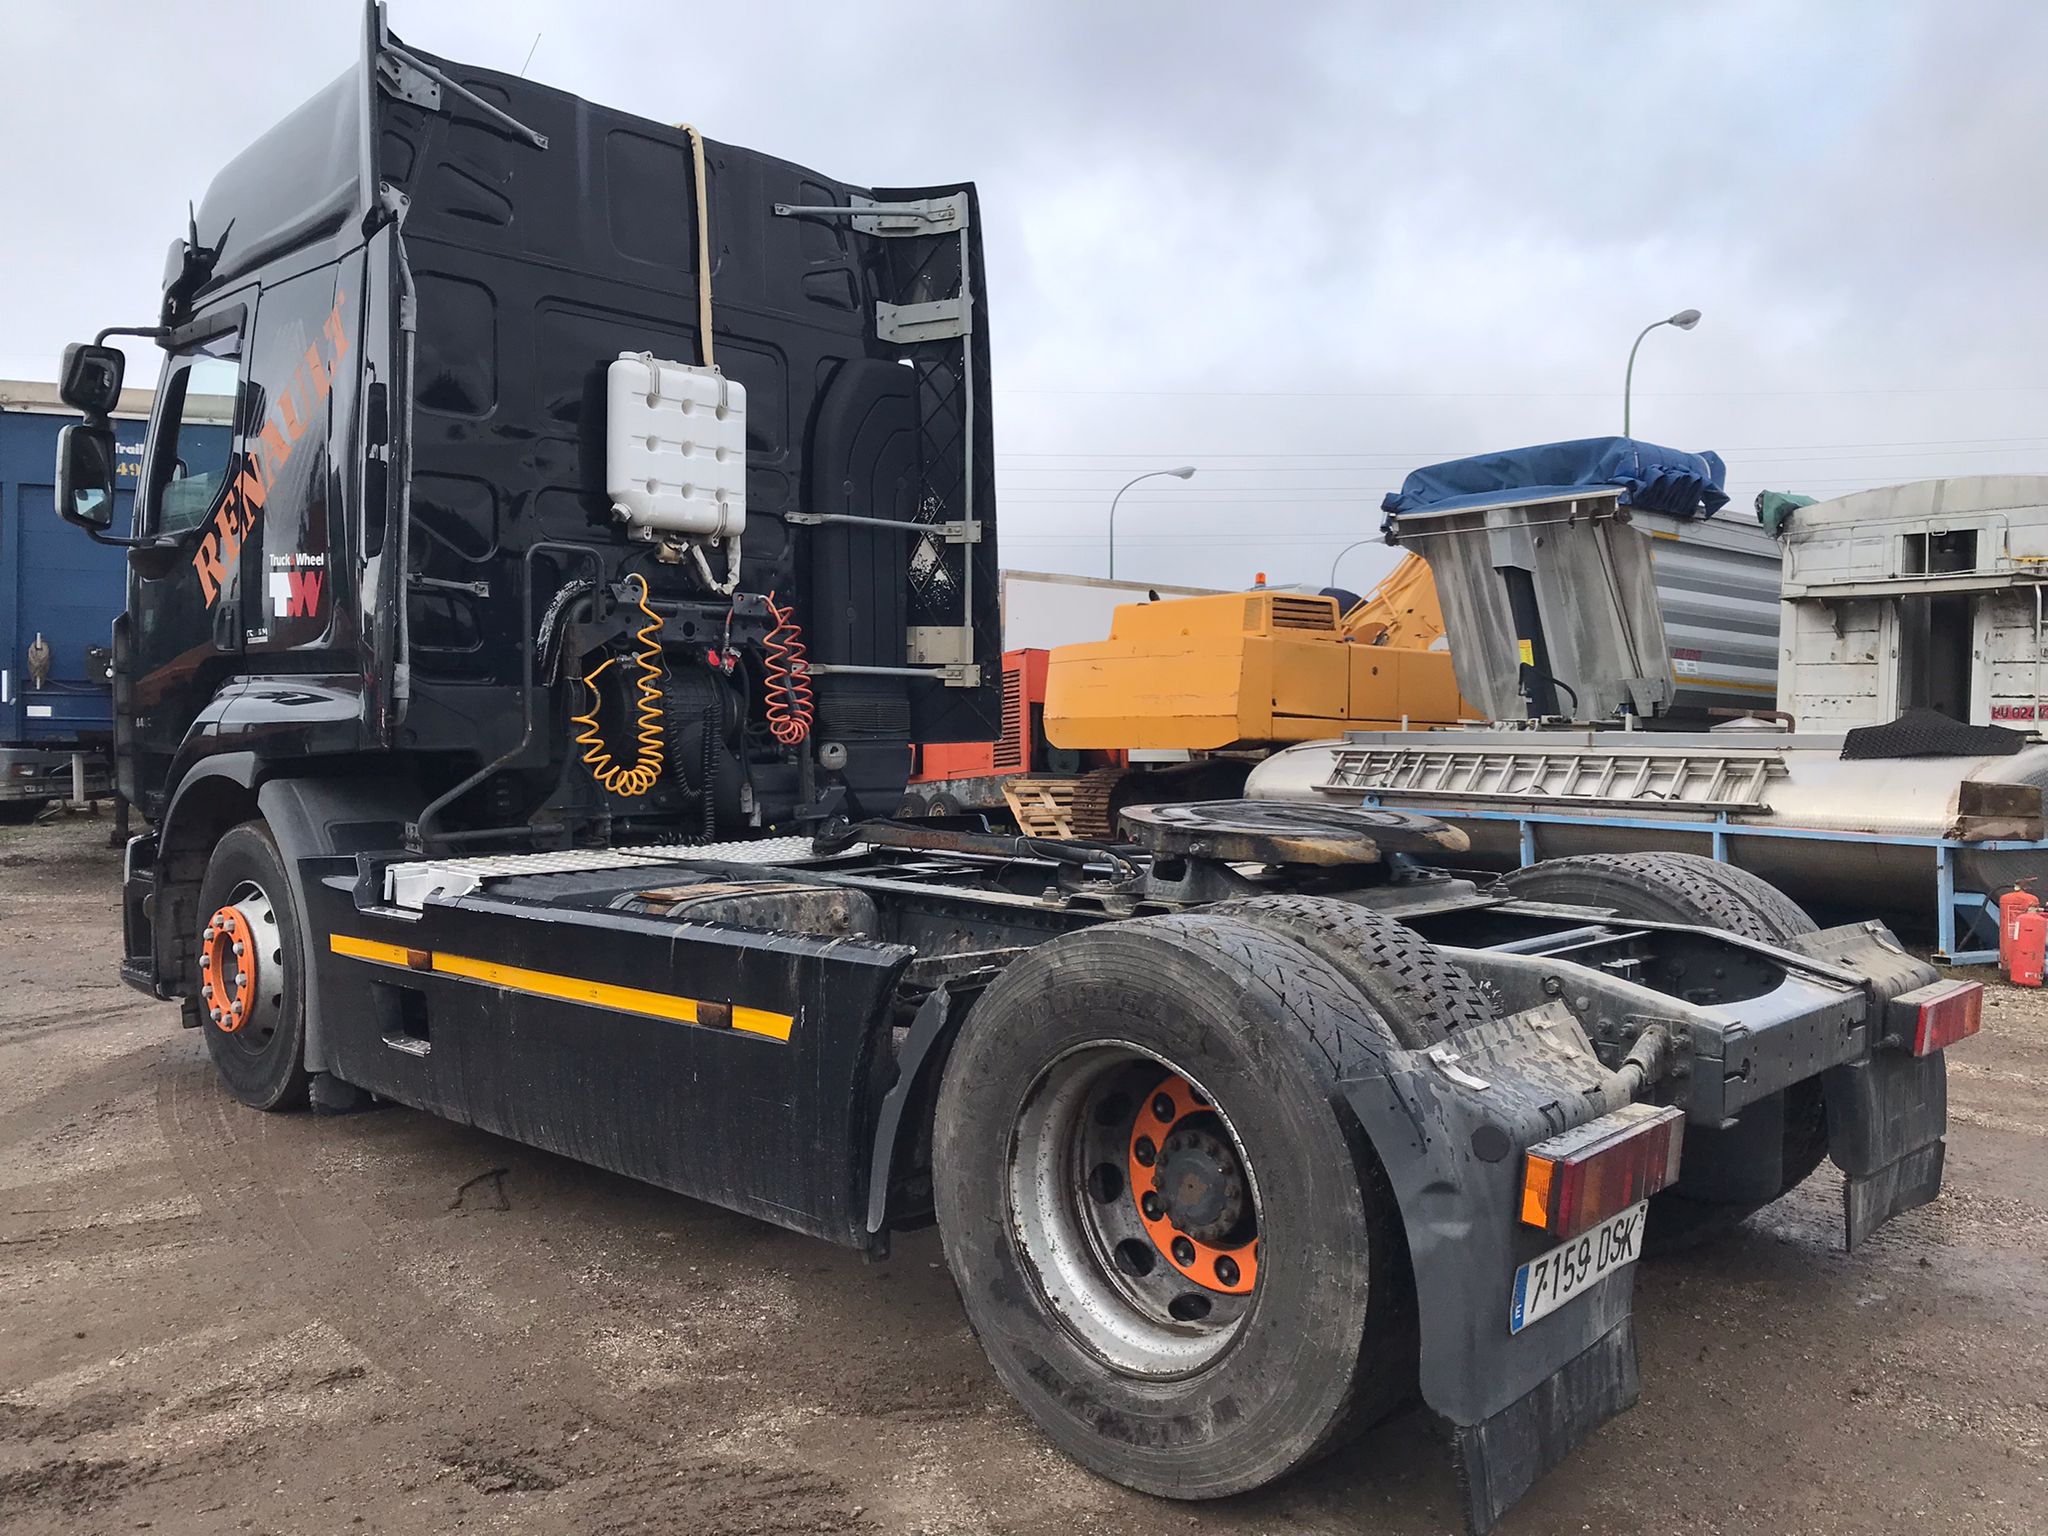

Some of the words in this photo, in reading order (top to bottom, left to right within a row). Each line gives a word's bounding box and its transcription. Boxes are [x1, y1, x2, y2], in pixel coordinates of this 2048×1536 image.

[193, 289, 349, 609] RENAULT
[296, 553, 324, 566] Wheel
[1531, 1236, 1592, 1314] 7159
[1597, 1213, 1638, 1272] DSK
